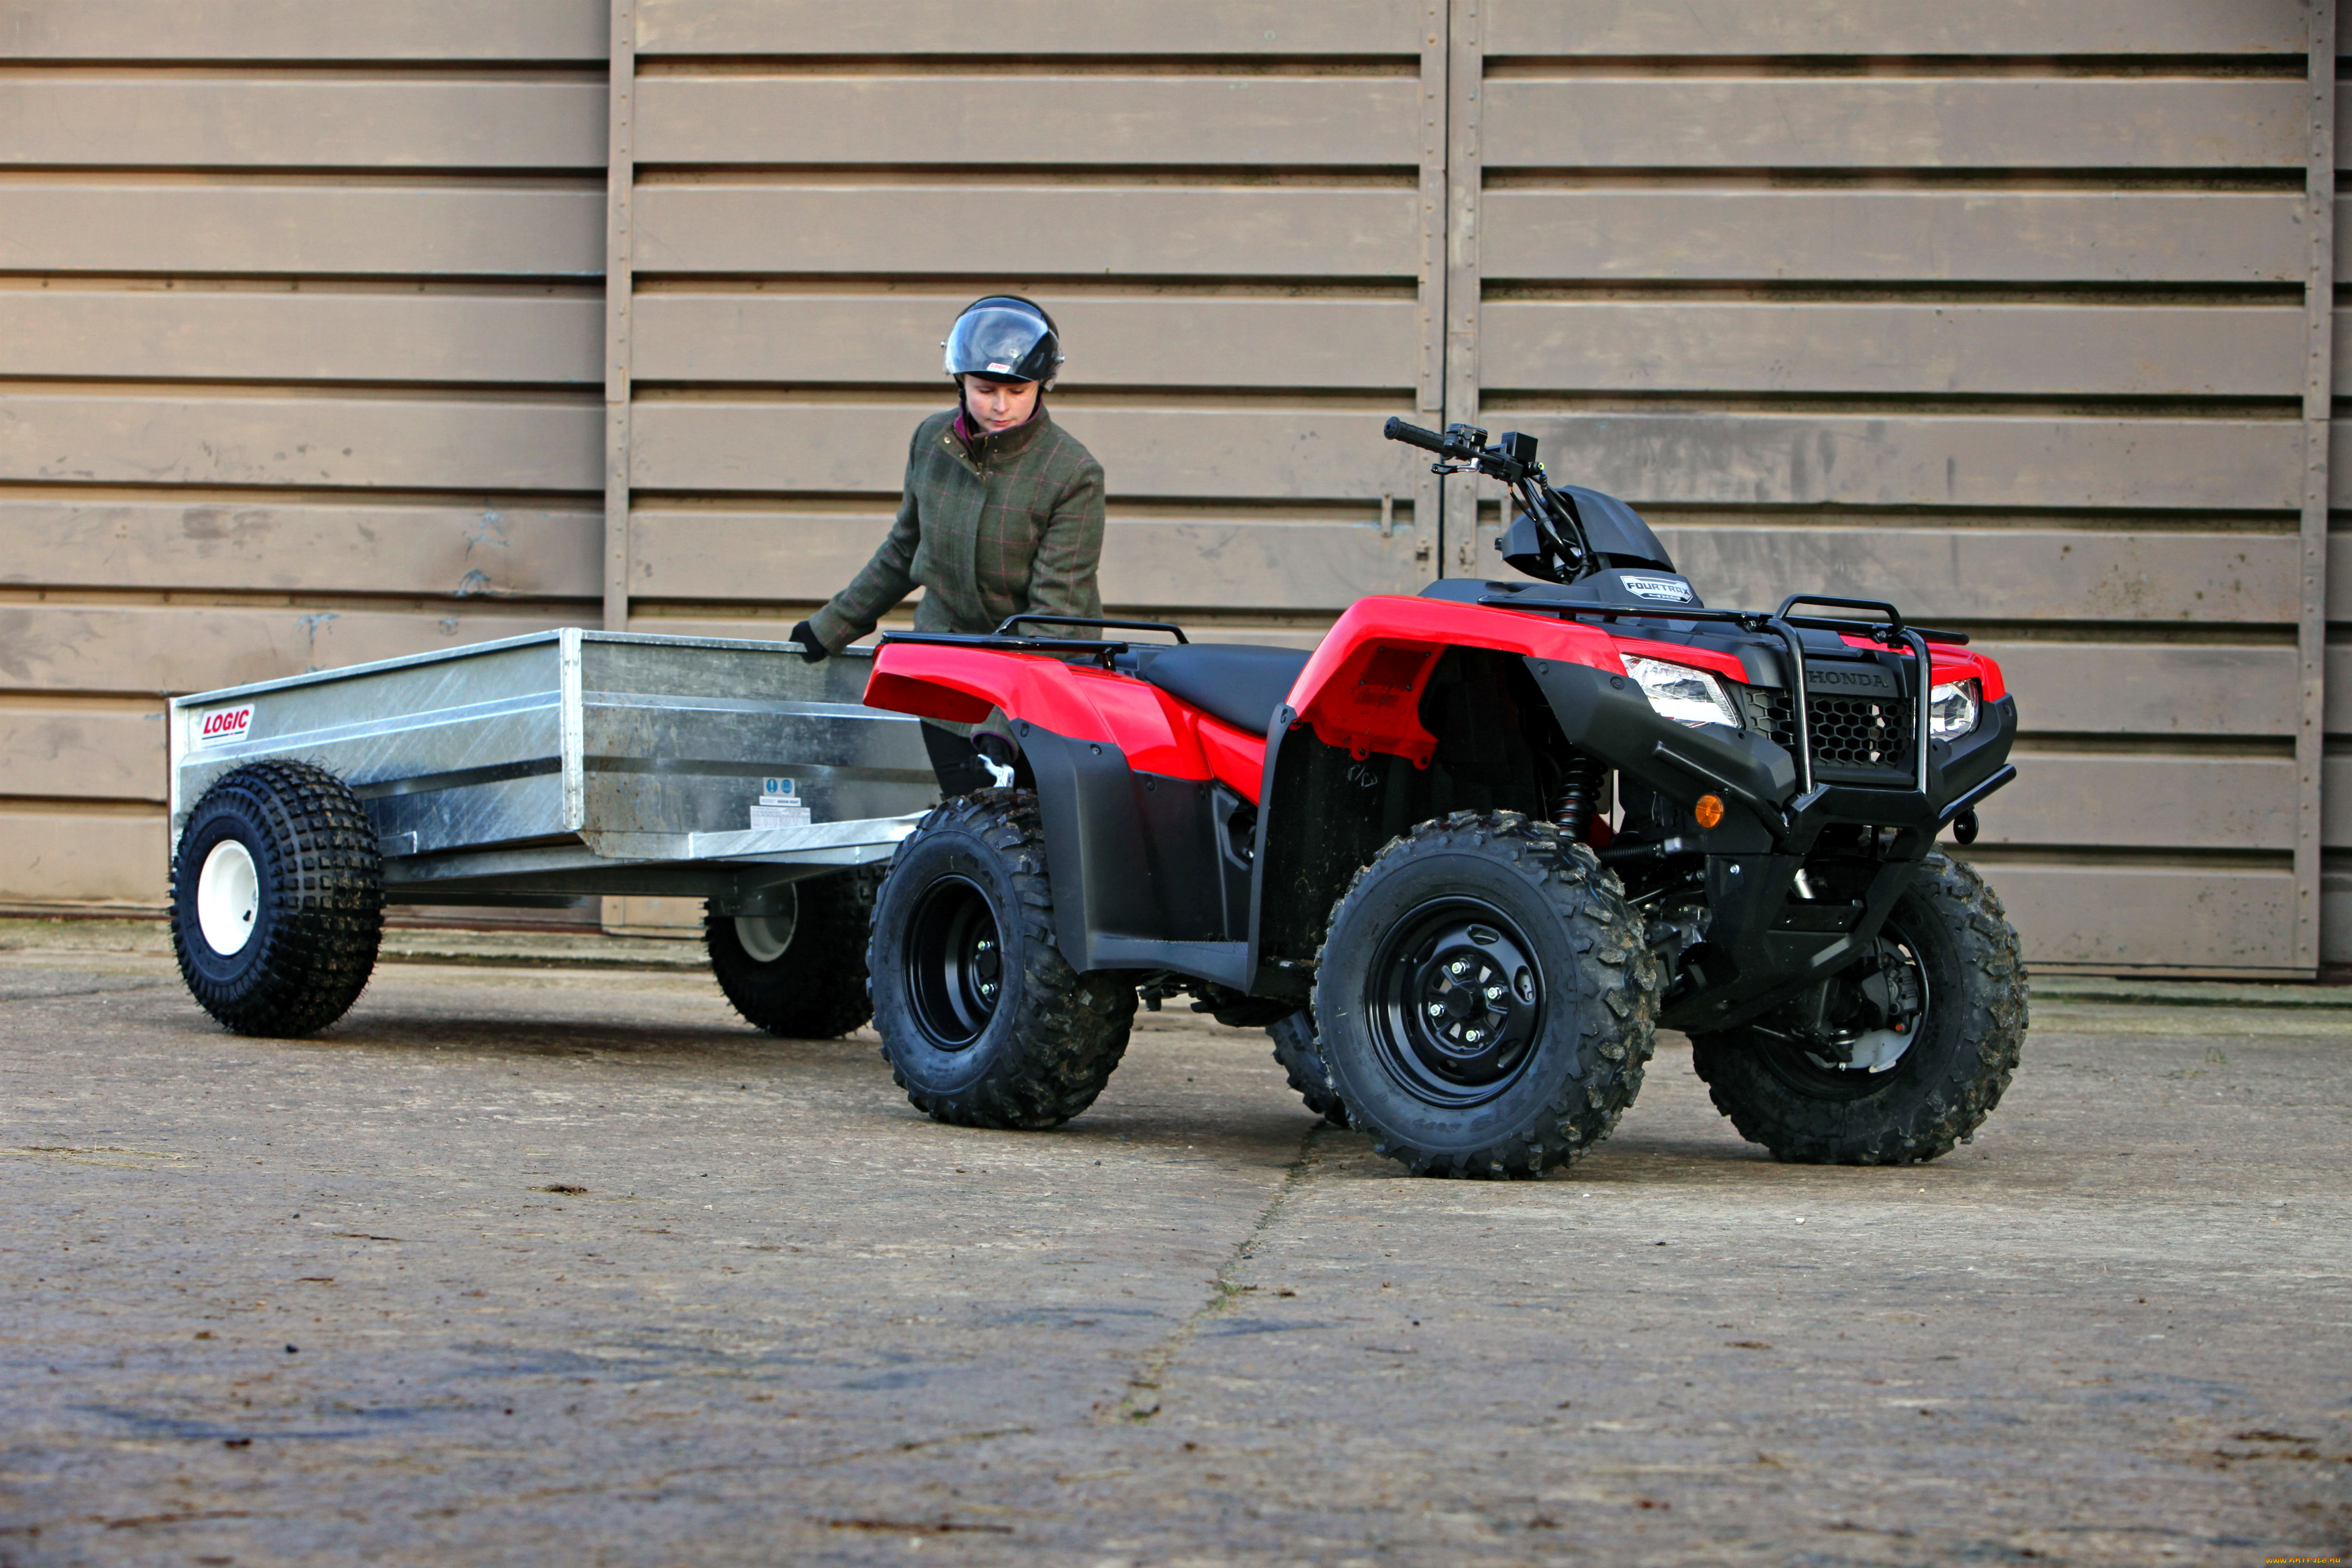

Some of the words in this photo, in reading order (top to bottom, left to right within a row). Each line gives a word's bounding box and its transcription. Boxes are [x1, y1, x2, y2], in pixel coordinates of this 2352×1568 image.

[1627, 583, 1690, 595] FOURTRAX
[1806, 671, 1889, 688] HONDA
[203, 709, 249, 734] LOGIC
